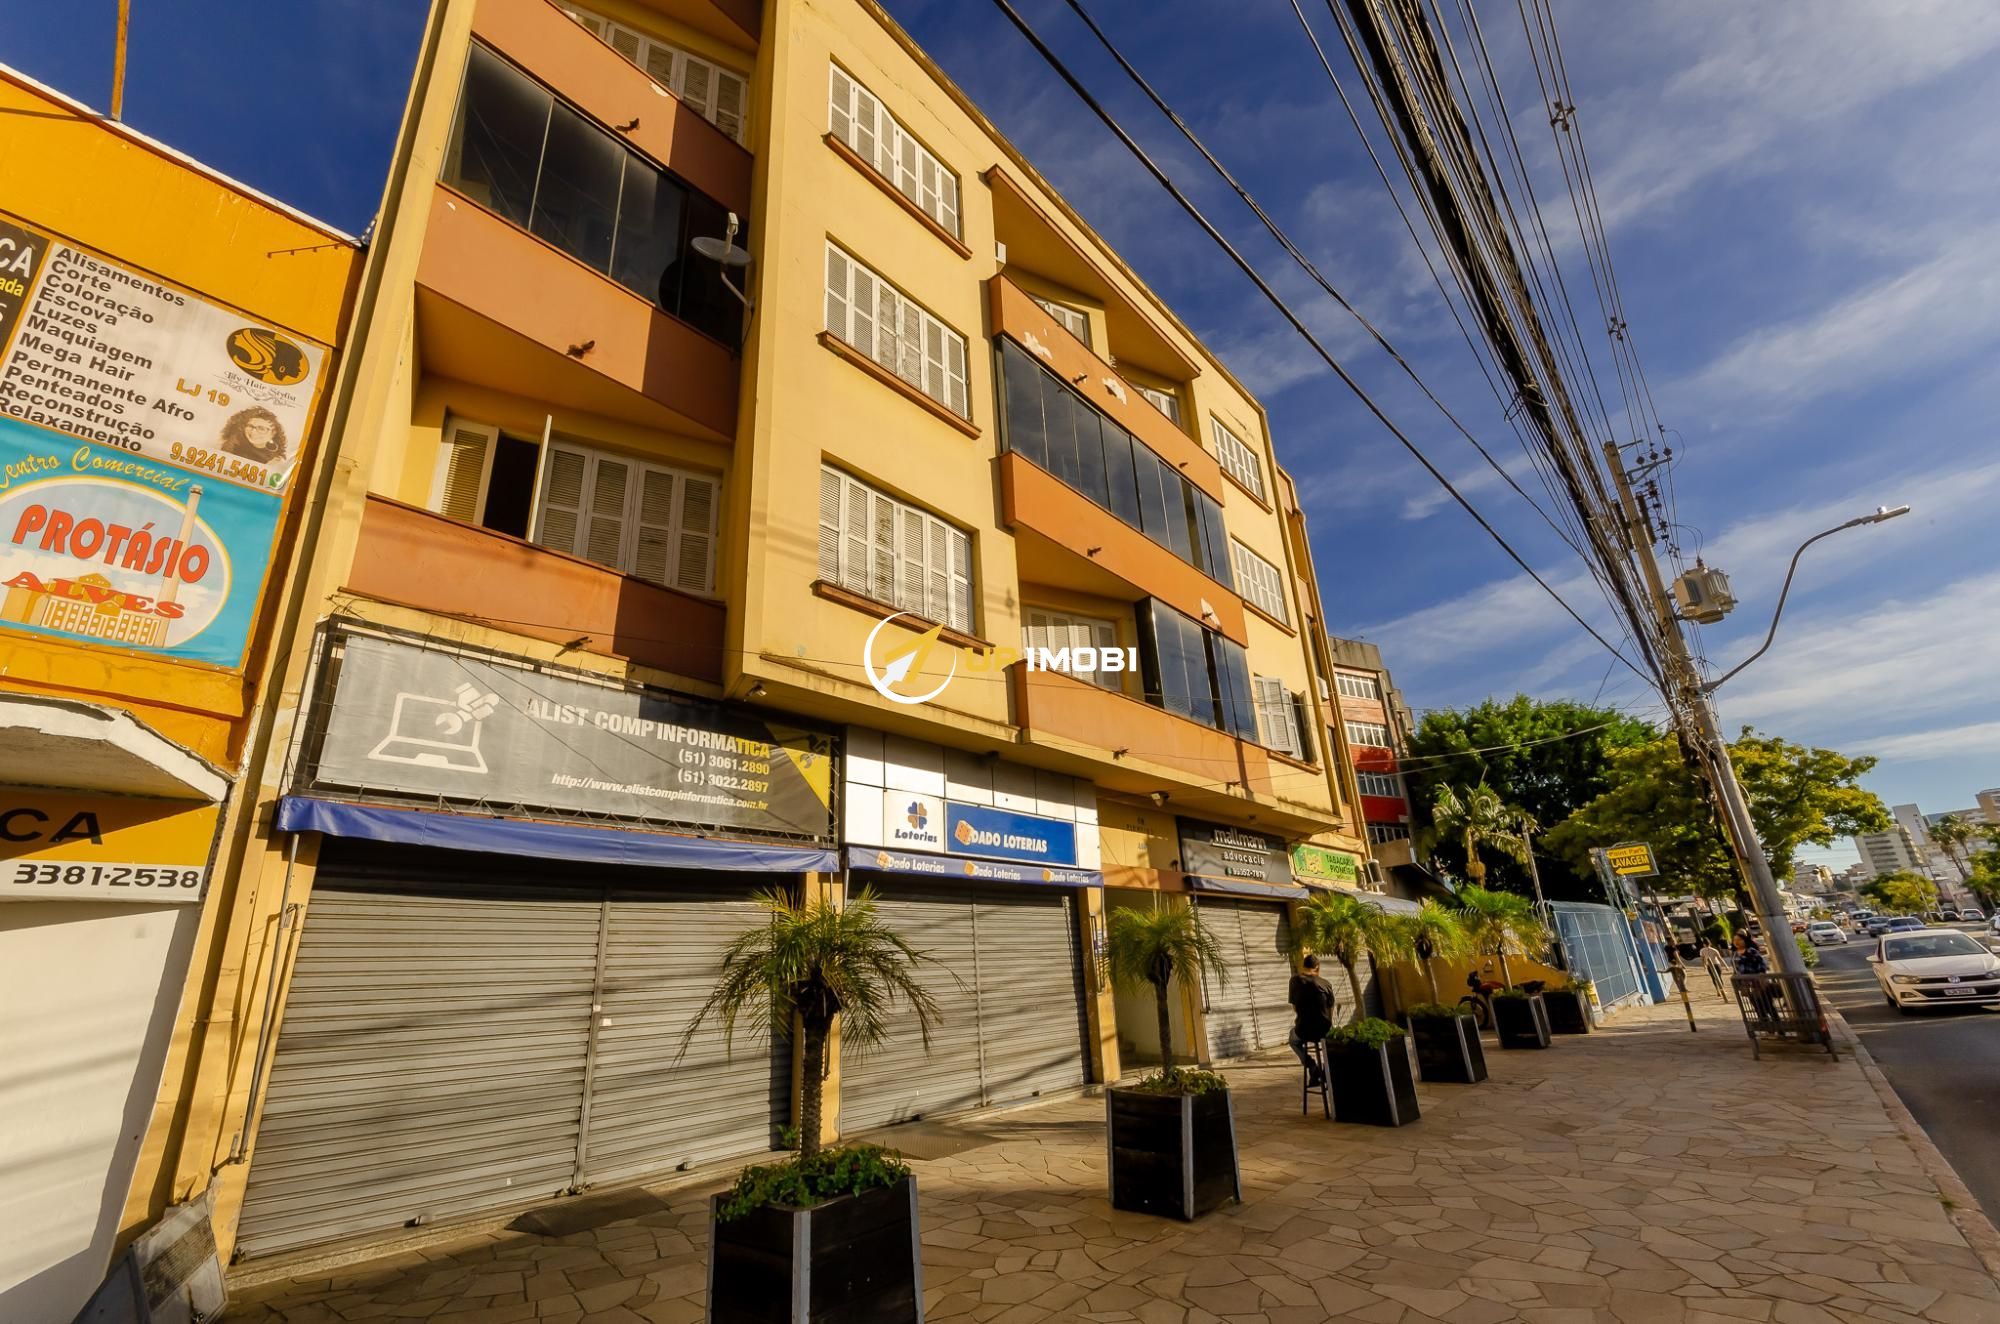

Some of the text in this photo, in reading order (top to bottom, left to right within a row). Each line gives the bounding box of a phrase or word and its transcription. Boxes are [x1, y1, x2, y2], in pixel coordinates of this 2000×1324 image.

[51, 260, 111, 292] Corte
[56, 248, 185, 306] Alisamentos
[33, 300, 97, 334] Luzes
[38, 286, 117, 326] Escova
[46, 274, 154, 323] Coloração
[19, 332, 135, 382] Mega Hair
[26, 314, 152, 370] Maquiagem
[5, 366, 124, 414] Penteados
[11, 350, 195, 421] Permanente Afro
[176, 378, 231, 407] LJ 19
[0, 380, 155, 440] Reconstrução
[70, 446, 190, 491] Comercial
[171, 441, 267, 487] 9.9241.5481
[12, 505, 209, 583] PROTÁSIO
[1, 571, 185, 619] ALVES
[525, 698, 771, 759] ALIST COMP INFORMATICA
[678, 768, 769, 793] (51) 3022.2897
[679, 749, 770, 775] (51) 3061.2890
[0, 808, 103, 845] CA
[894, 828, 938, 843] Loterias
[971, 830, 1048, 853] DADO LOTERIAS
[1213, 827, 1267, 850] mallmann
[888, 856, 945, 874] Dado Loterias
[974, 865, 1021, 881] Dado Loterias
[1223, 850, 1266, 866] advocacia
[1611, 854, 1650, 868] LAVAGEM
